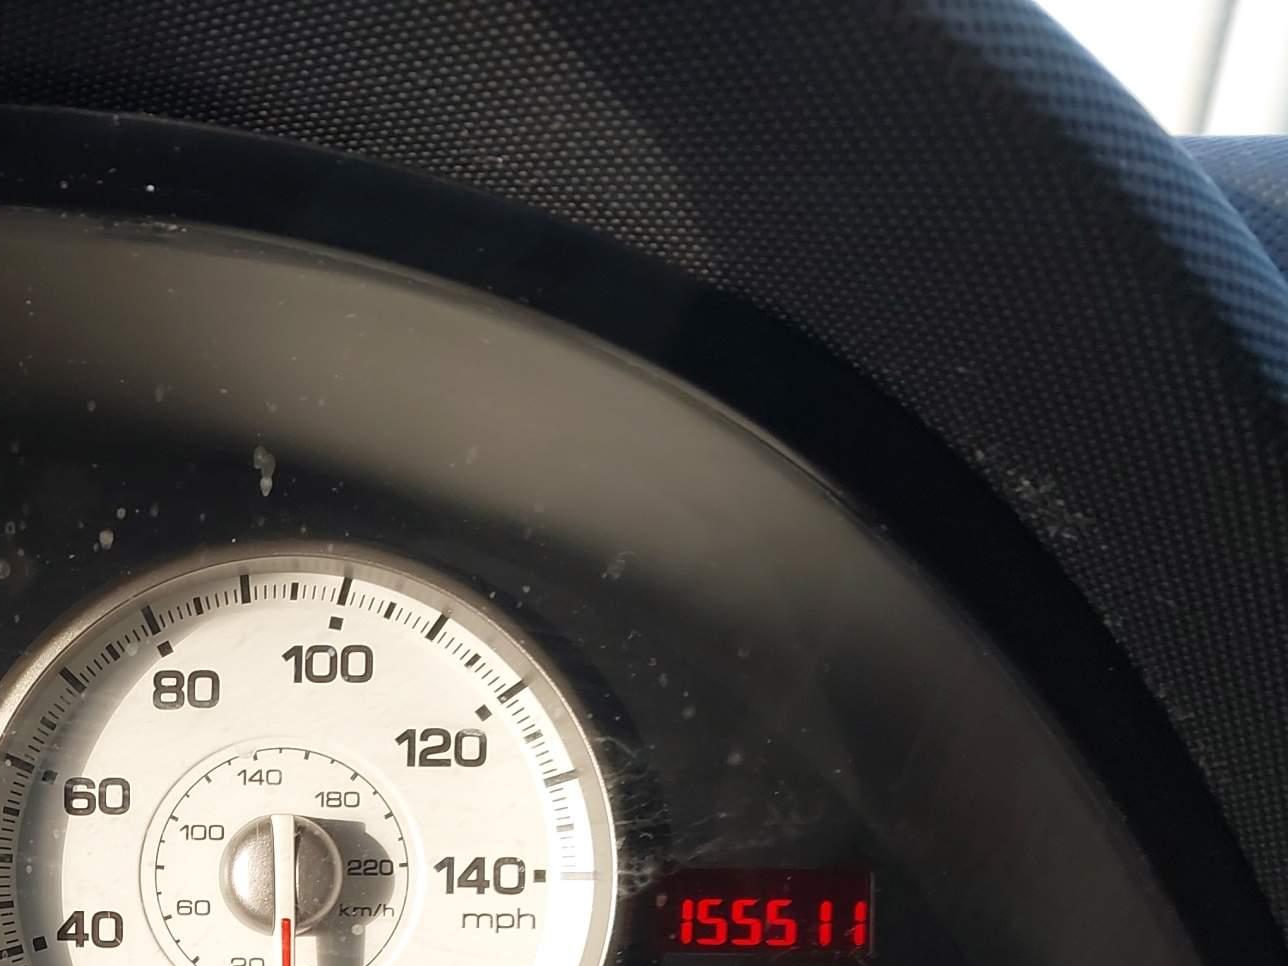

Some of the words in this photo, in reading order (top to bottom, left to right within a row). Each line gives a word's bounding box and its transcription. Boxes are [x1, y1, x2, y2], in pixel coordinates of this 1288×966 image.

[282, 644, 374, 684] 100
[152, 669, 221, 710] 80
[395, 727, 488, 768] 120
[237, 769, 283, 787] 140
[63, 777, 132, 817] 60
[315, 791, 361, 809] 180
[179, 823, 225, 842] 100
[347, 859, 395, 877] 220
[433, 857, 526, 896] 140
[176, 898, 212, 917] 60
[338, 901, 396, 919] km/h
[462, 908, 537, 932] mph
[56, 910, 124, 949] 40
[680, 899, 868, 948] 155511
